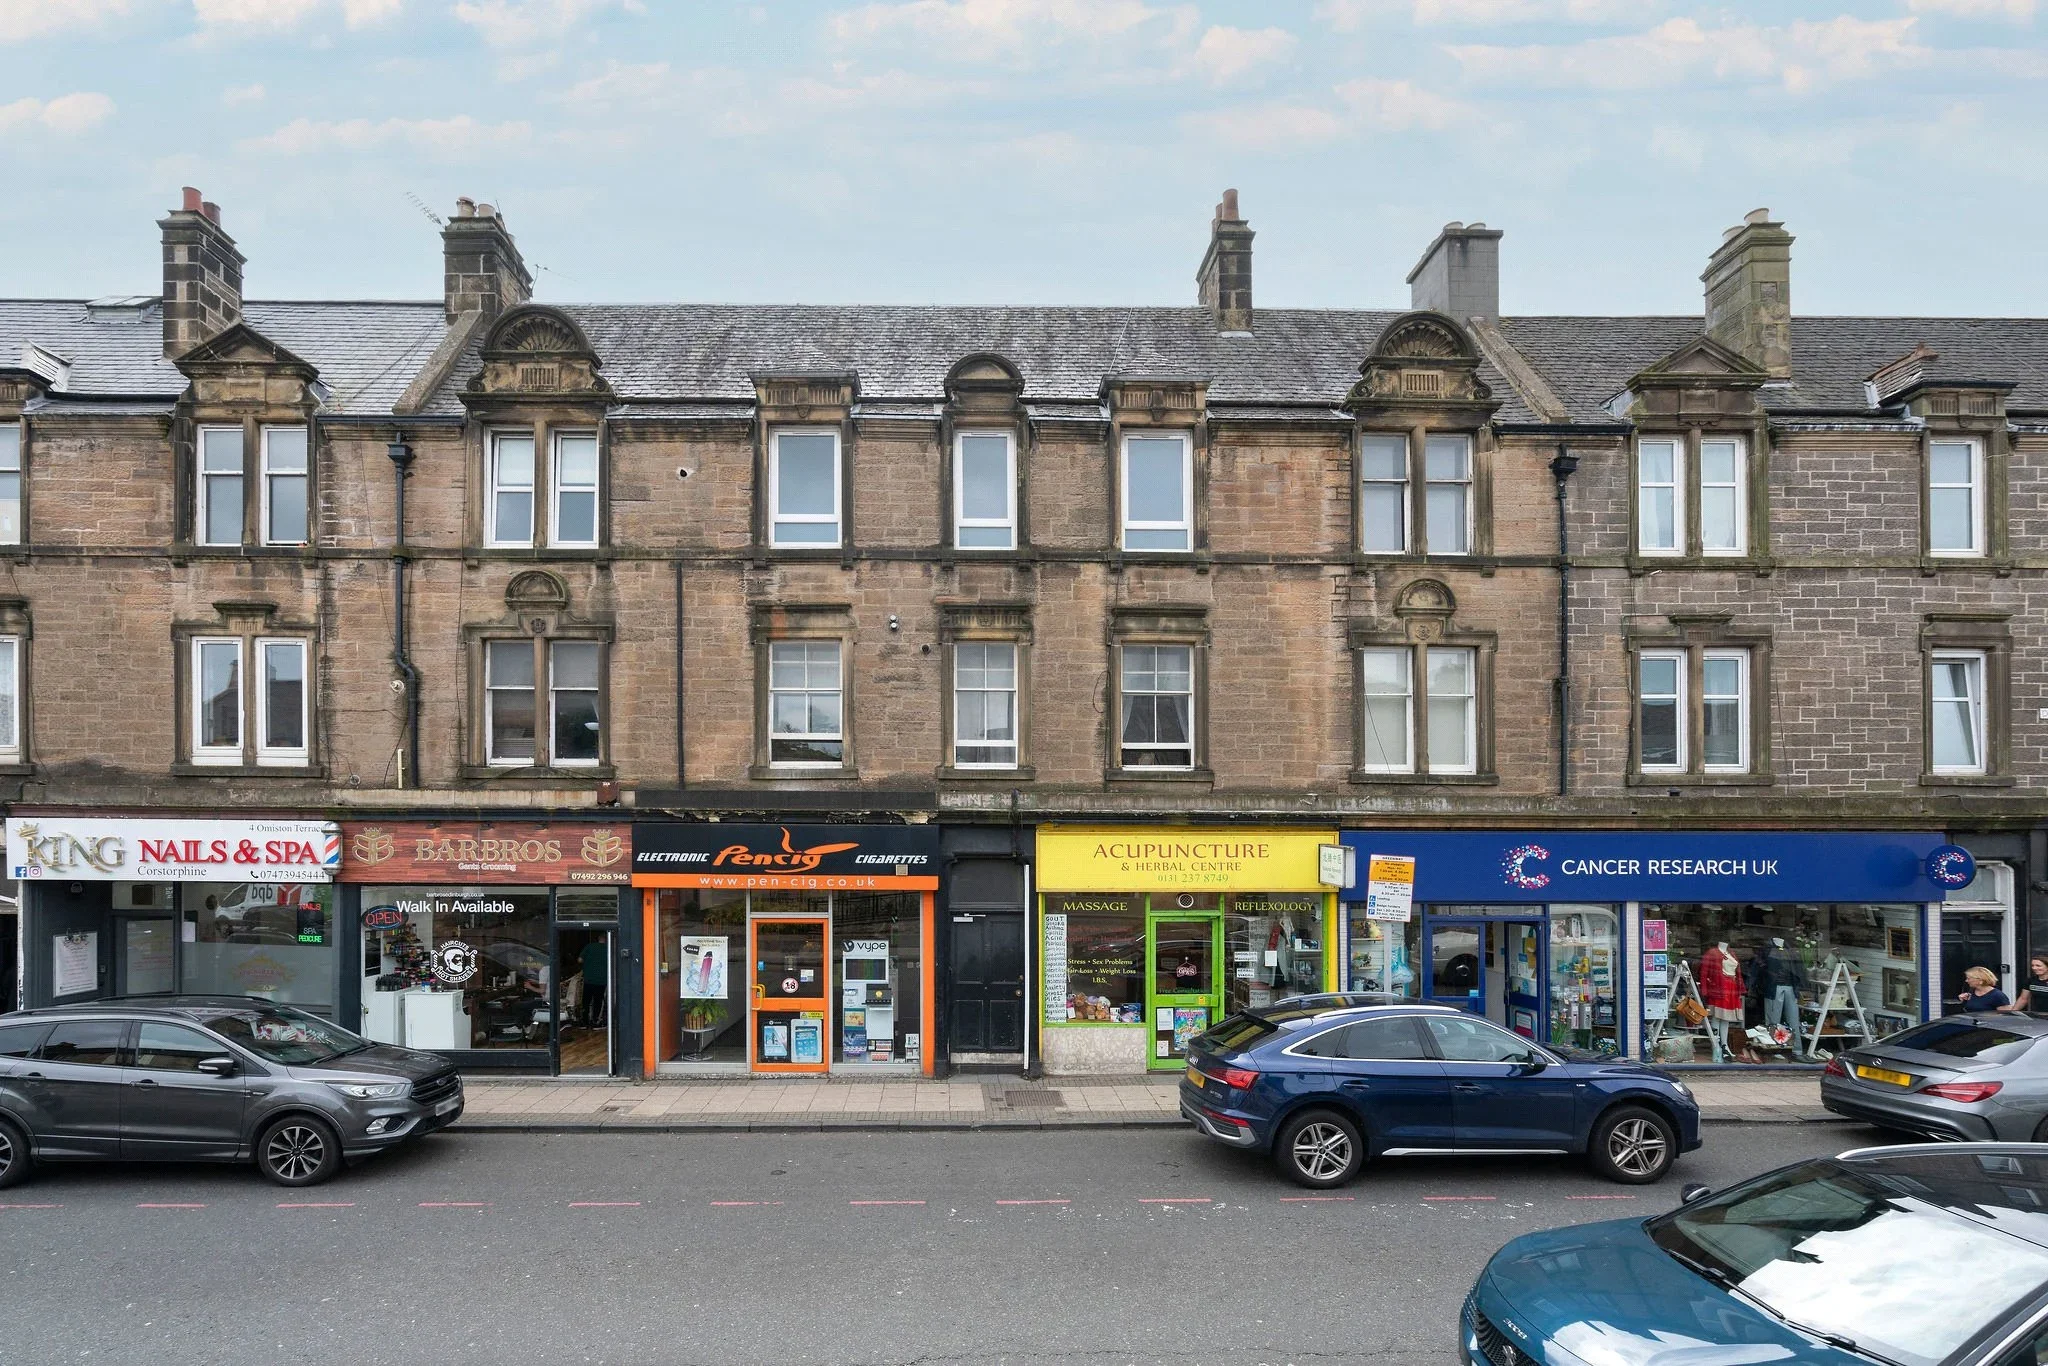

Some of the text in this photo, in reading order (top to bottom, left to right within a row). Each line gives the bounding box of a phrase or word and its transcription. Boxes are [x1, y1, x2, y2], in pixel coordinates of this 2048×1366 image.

[294, 824, 322, 833] Terrac
[24, 832, 321, 873] KING NAILS & SPA
[415, 838, 562, 863] BARBROS
[1093, 843, 1270, 859] ACUPUNCTURE
[636, 852, 710, 863] ELECTRONIC
[712, 843, 840, 873] Pencig
[855, 853, 929, 865] CIGARETTES
[137, 866, 207, 879] Corstorphine
[458, 862, 517, 873] Gents Grooming
[1121, 862, 1242, 872] & HERBAL CENTRE
[1561, 859, 1779, 875] CANCER RESEARCH UK
[260, 870, 325, 880] 07473945444
[571, 872, 595, 880] 07492
[596, 872, 612, 880] 296
[1157, 873, 1229, 883] 0131 237 8749
[699, 876, 876, 889] www.pen-cig.co.uk
[299, 903, 321, 911] NAILS
[396, 900, 515, 913] Walk In Available
[1062, 901, 1128, 911] MASSAGE
[1235, 901, 1314, 911] REFLEXOLOGY
[365, 911, 403, 926] OPEN
[303, 927, 317, 935] SPA
[298, 935, 323, 943] PEDICURE
[440, 940, 470, 950] HAIRCUTS
[857, 941, 887, 953] vype
[437, 969, 449, 980] HOT
[1099, 967, 1121, 975] Weight
[1502, 1317, 1528, 1340] 3008
